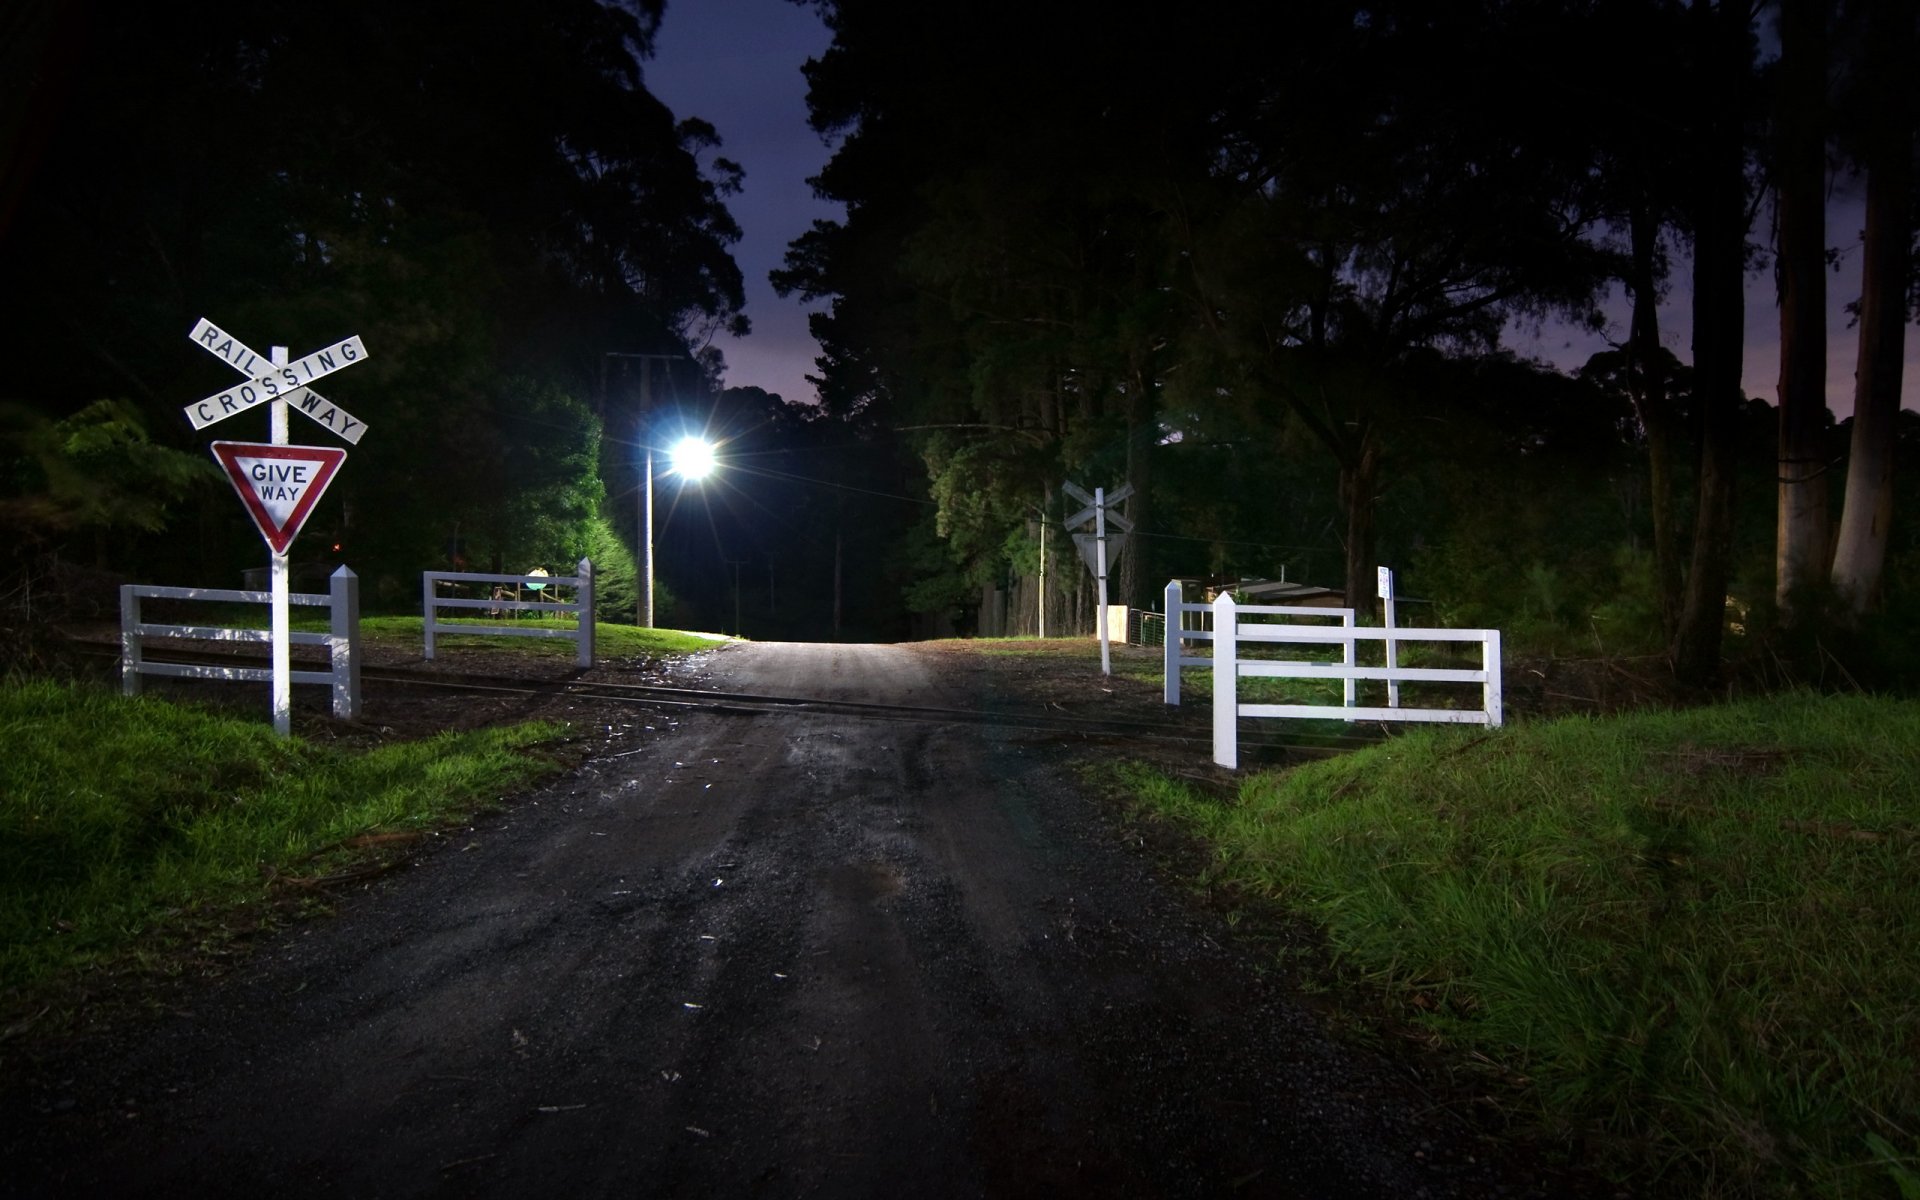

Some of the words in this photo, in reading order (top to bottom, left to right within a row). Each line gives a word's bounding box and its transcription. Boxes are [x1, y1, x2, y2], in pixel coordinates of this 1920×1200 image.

[198, 343, 357, 422] CROSSING
[200, 326, 256, 375] RAIL
[301, 392, 358, 434] WAY
[252, 464, 307, 483] GIVE
[261, 486, 299, 501] WAY
